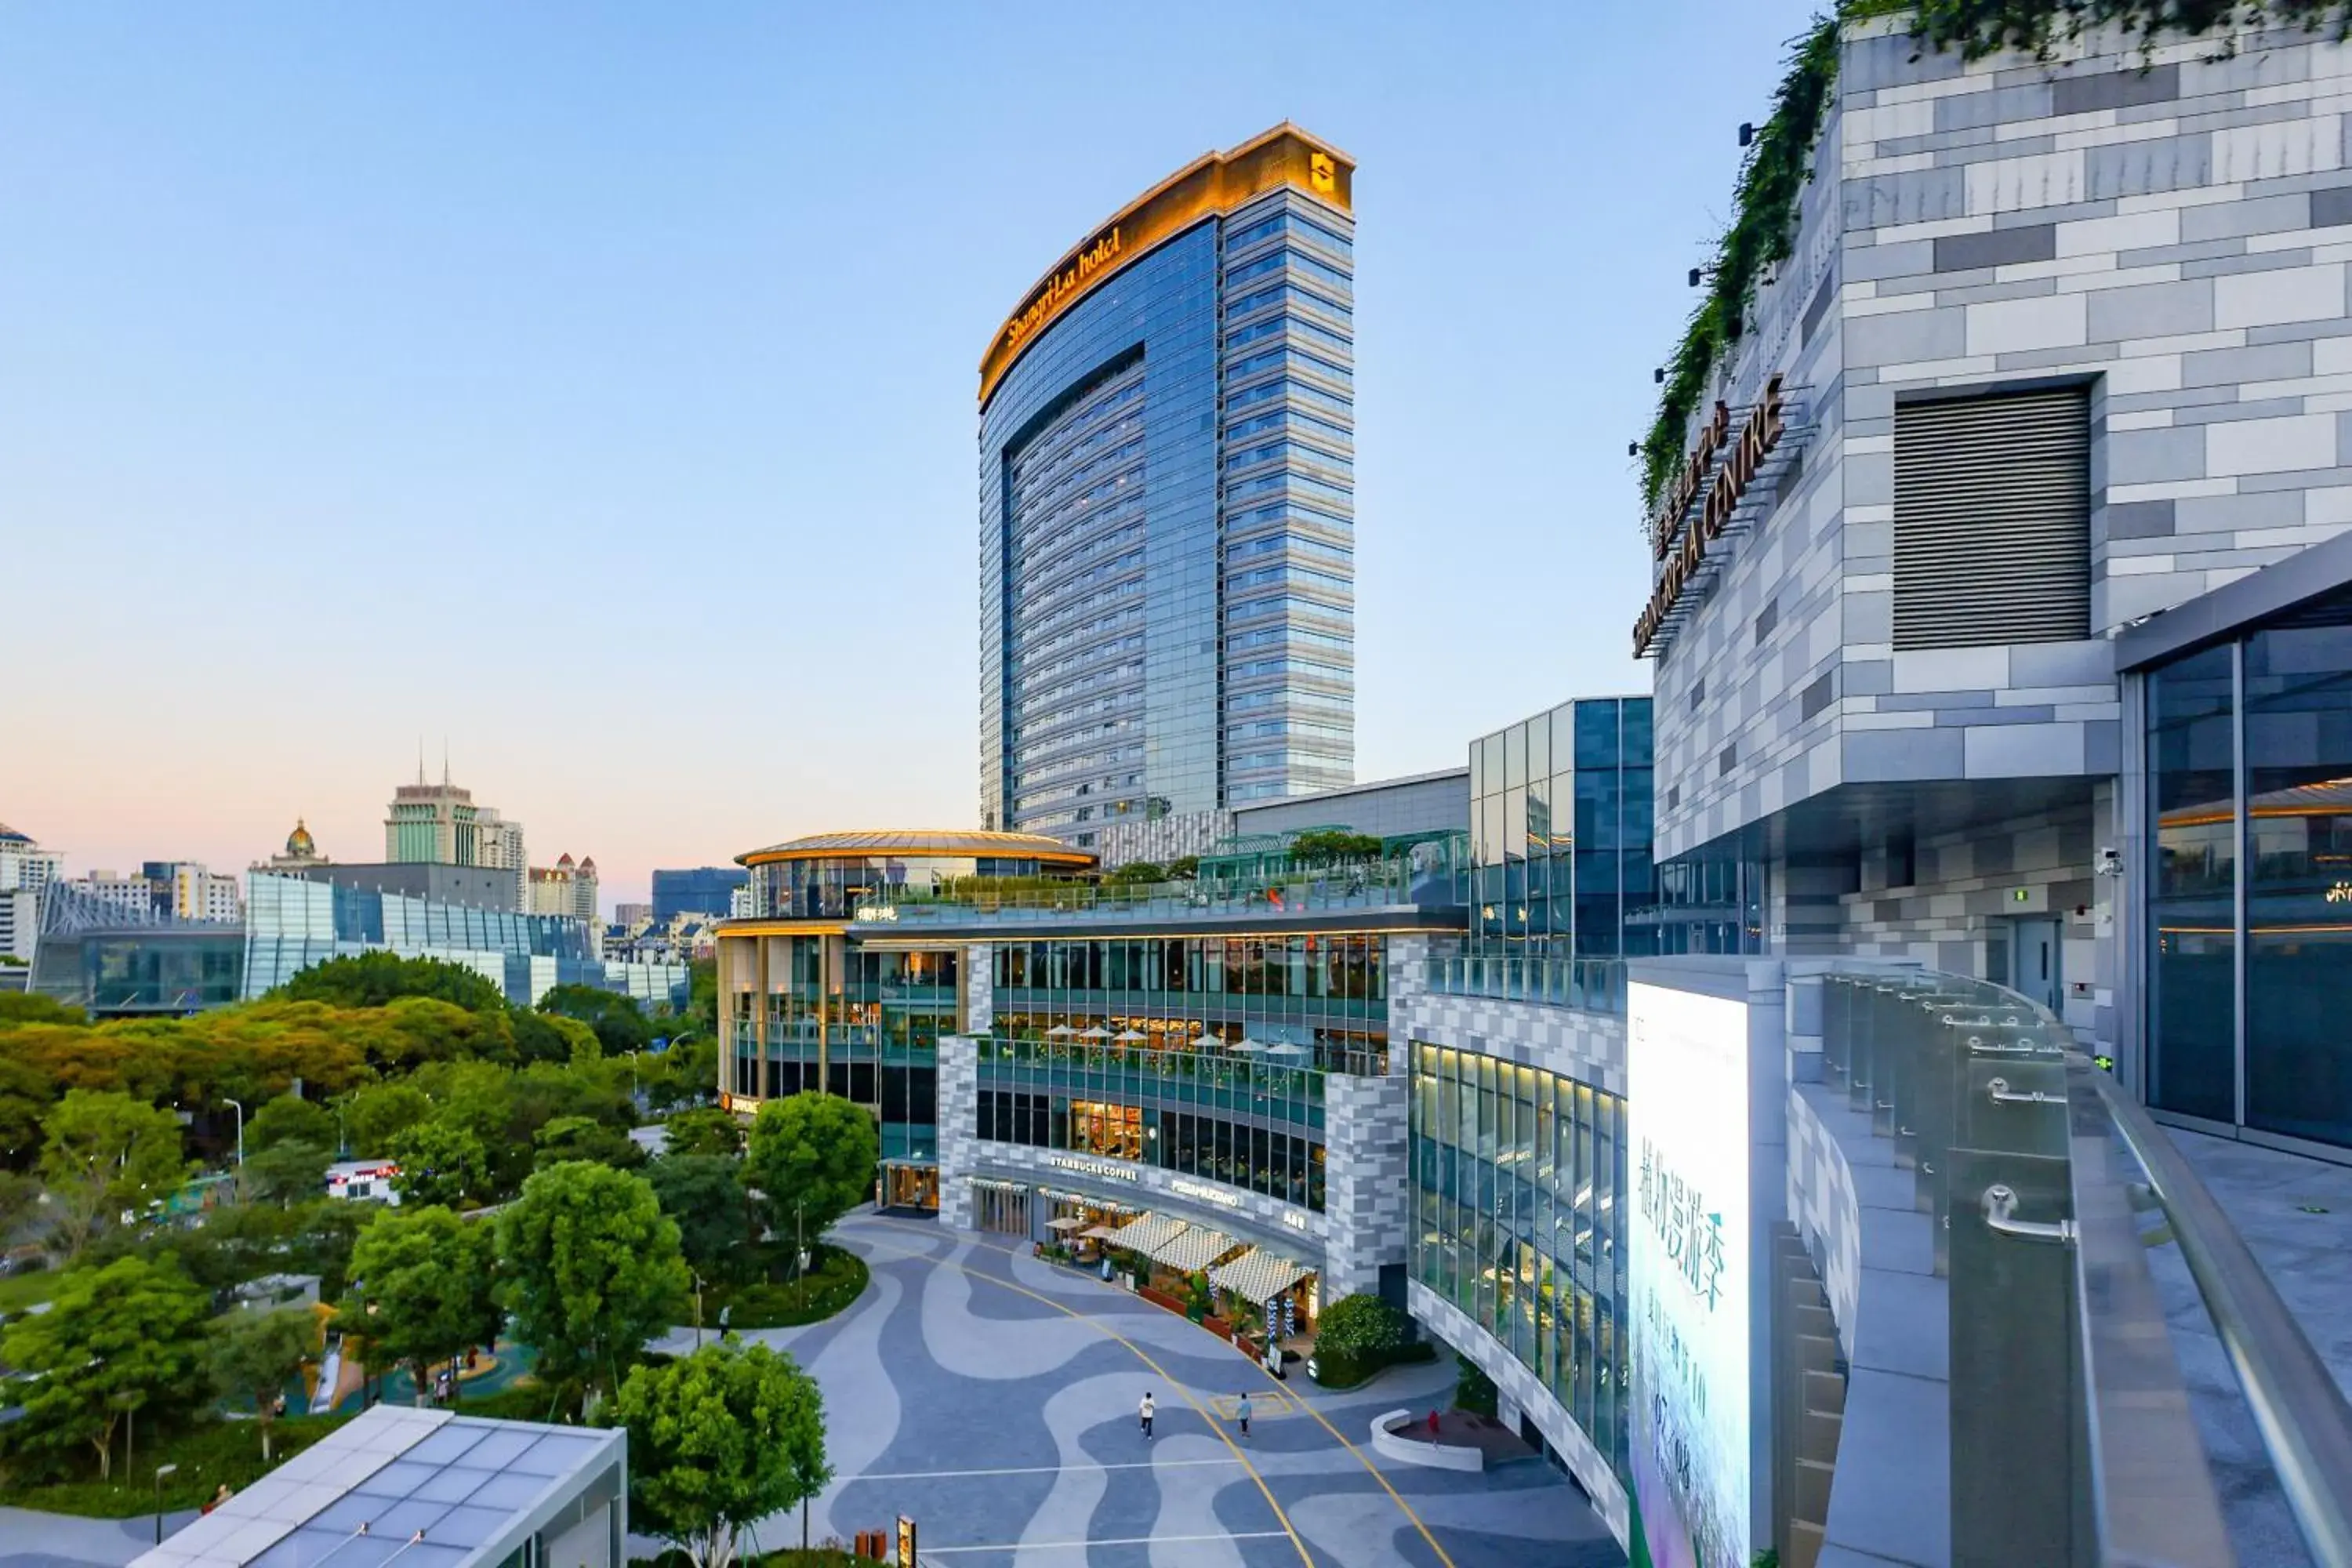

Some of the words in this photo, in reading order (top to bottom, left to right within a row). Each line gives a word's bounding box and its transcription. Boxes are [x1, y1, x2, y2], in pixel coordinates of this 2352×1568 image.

[1079, 227, 1120, 278] hotel
[1051, 1156, 1102, 1174] STARBUCKS
[1103, 1165, 1137, 1181] COFFEE
